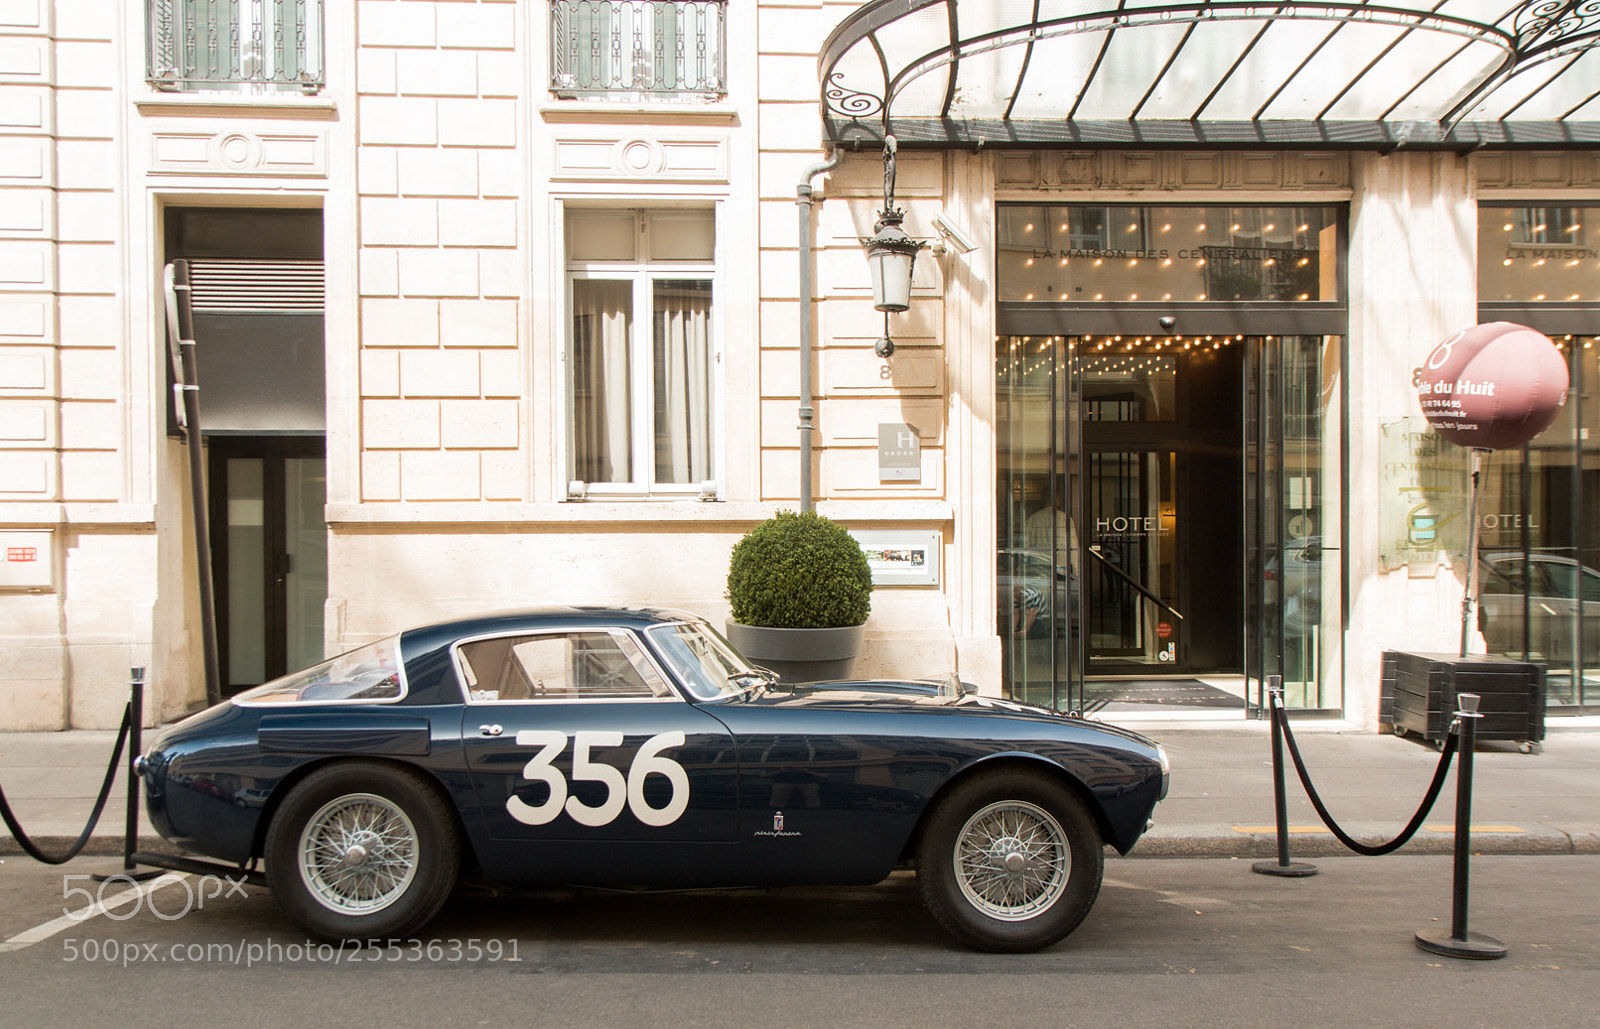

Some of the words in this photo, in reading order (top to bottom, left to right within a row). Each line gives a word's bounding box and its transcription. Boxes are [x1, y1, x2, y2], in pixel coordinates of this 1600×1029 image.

[1033, 249, 1054, 260] LA
[1060, 249, 1128, 260] MAISON
[1135, 250, 1169, 260] DES
[1178, 249, 1304, 260] CENTRALIENS
[1506, 249, 1526, 259] LA
[1533, 249, 1598, 259] MAISON
[880, 365, 892, 380] 8
[1434, 380, 1453, 394] du
[1456, 380, 1496, 396] Huit
[897, 431, 914, 449] H
[1096, 516, 1170, 532] HOTEL
[505, 730, 690, 827] 356
